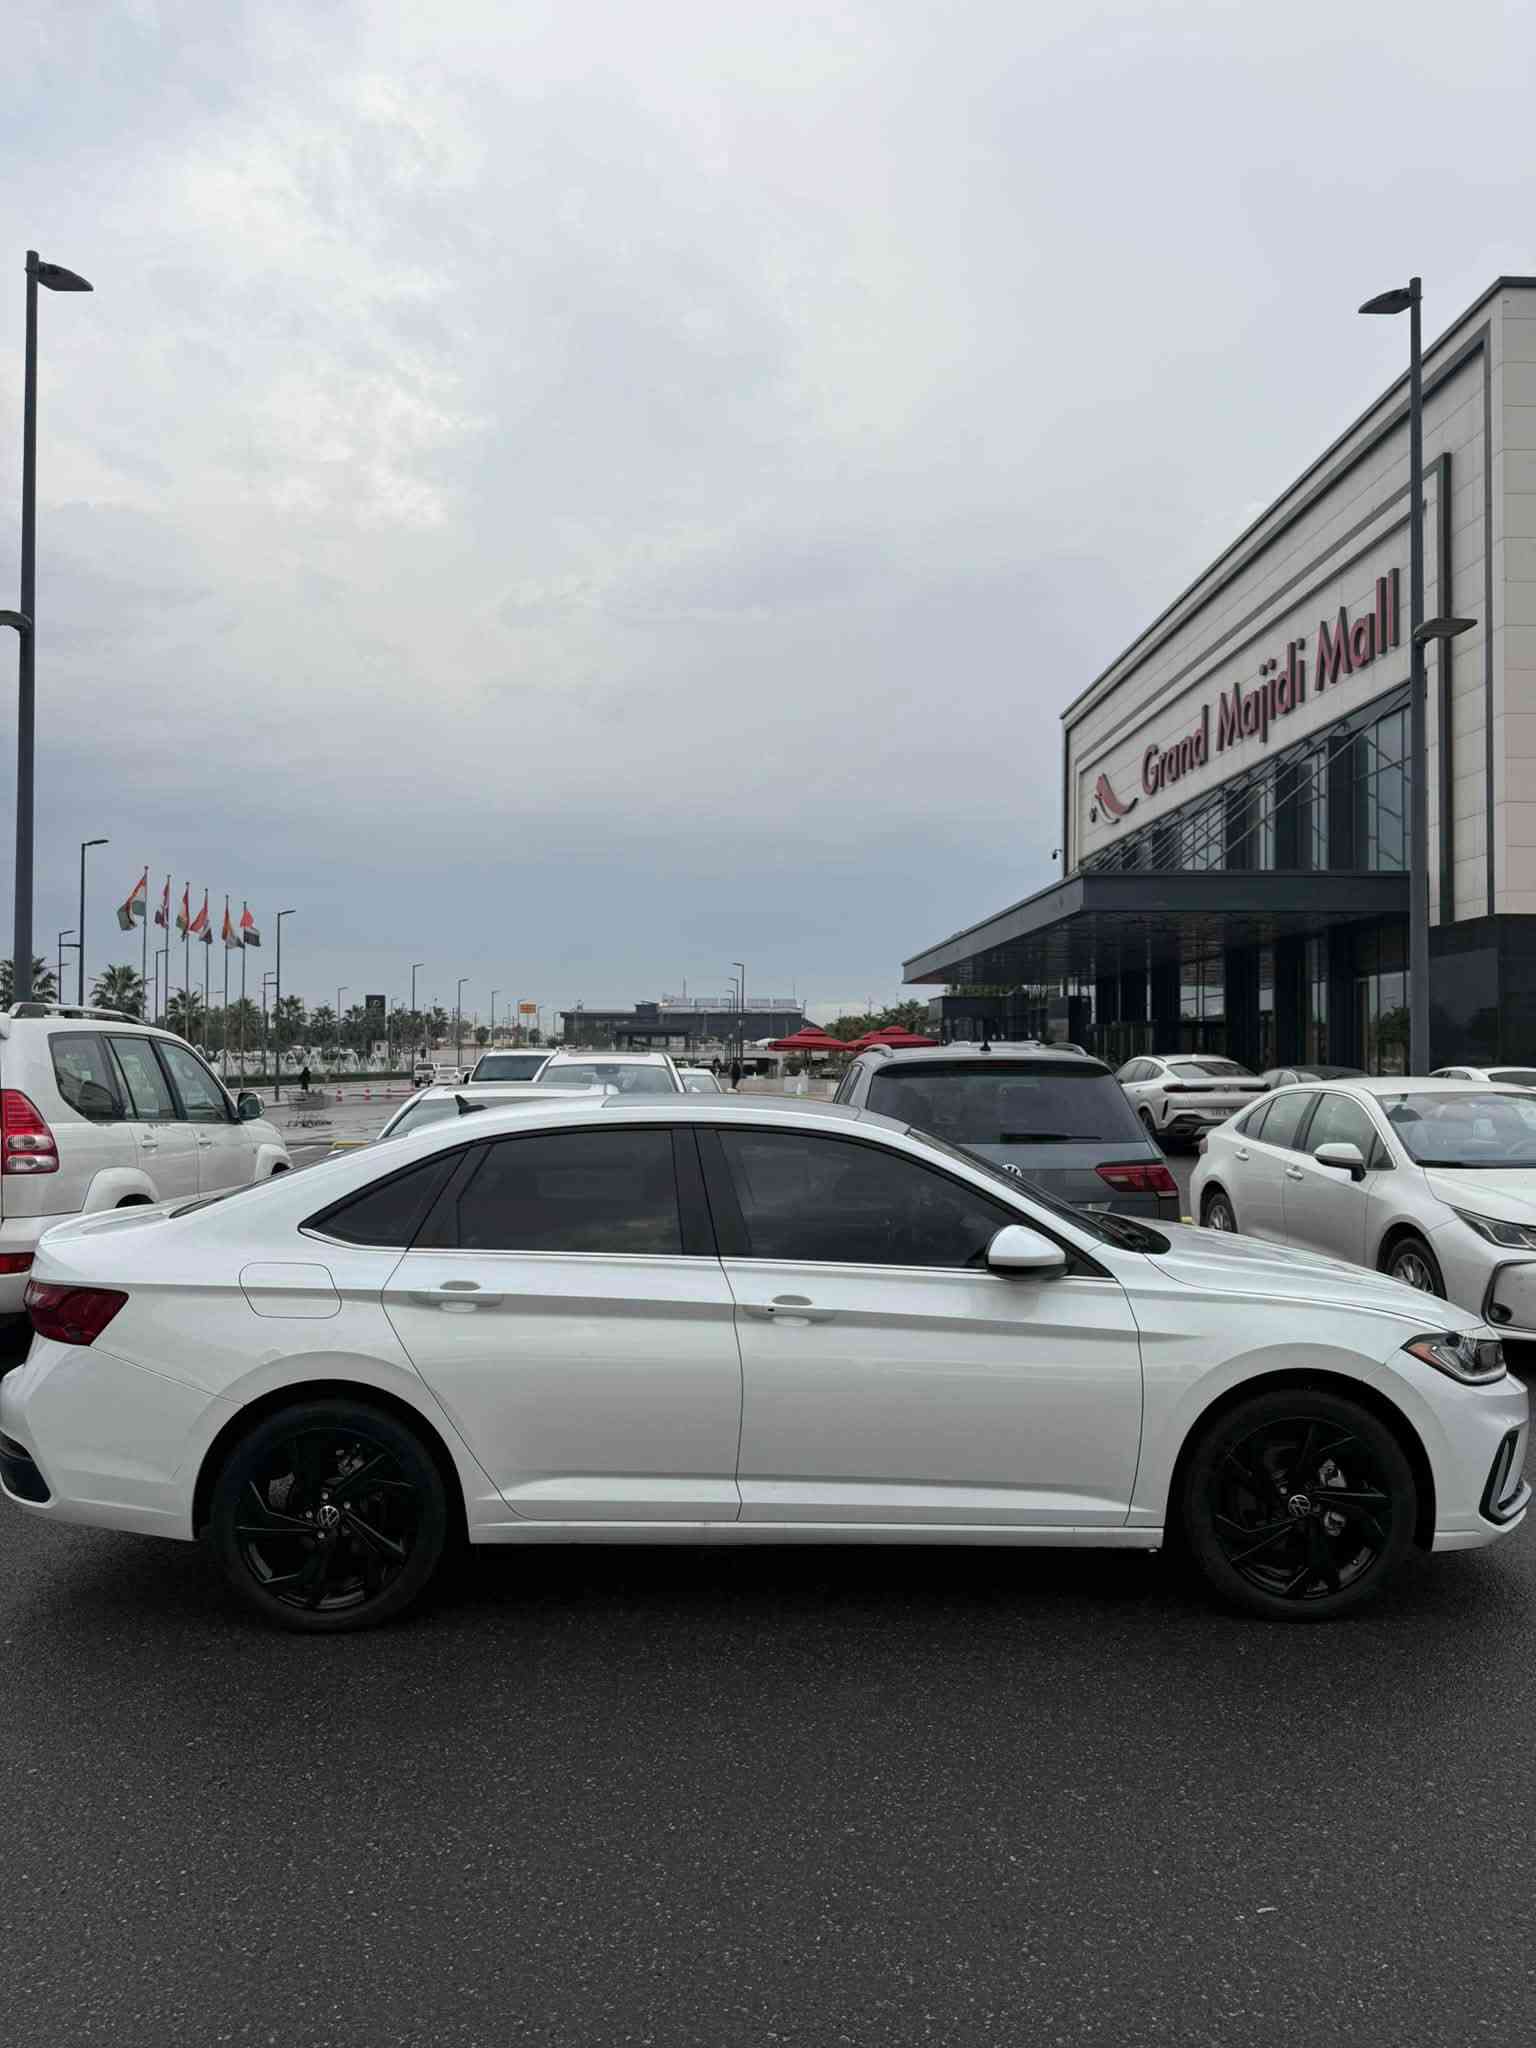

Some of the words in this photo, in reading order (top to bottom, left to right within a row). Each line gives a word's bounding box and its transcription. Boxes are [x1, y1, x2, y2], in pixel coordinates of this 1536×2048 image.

[1142, 704, 1209, 795] Grand
[1216, 638, 1306, 751] Majidi
[1315, 567, 1400, 691] Mall
